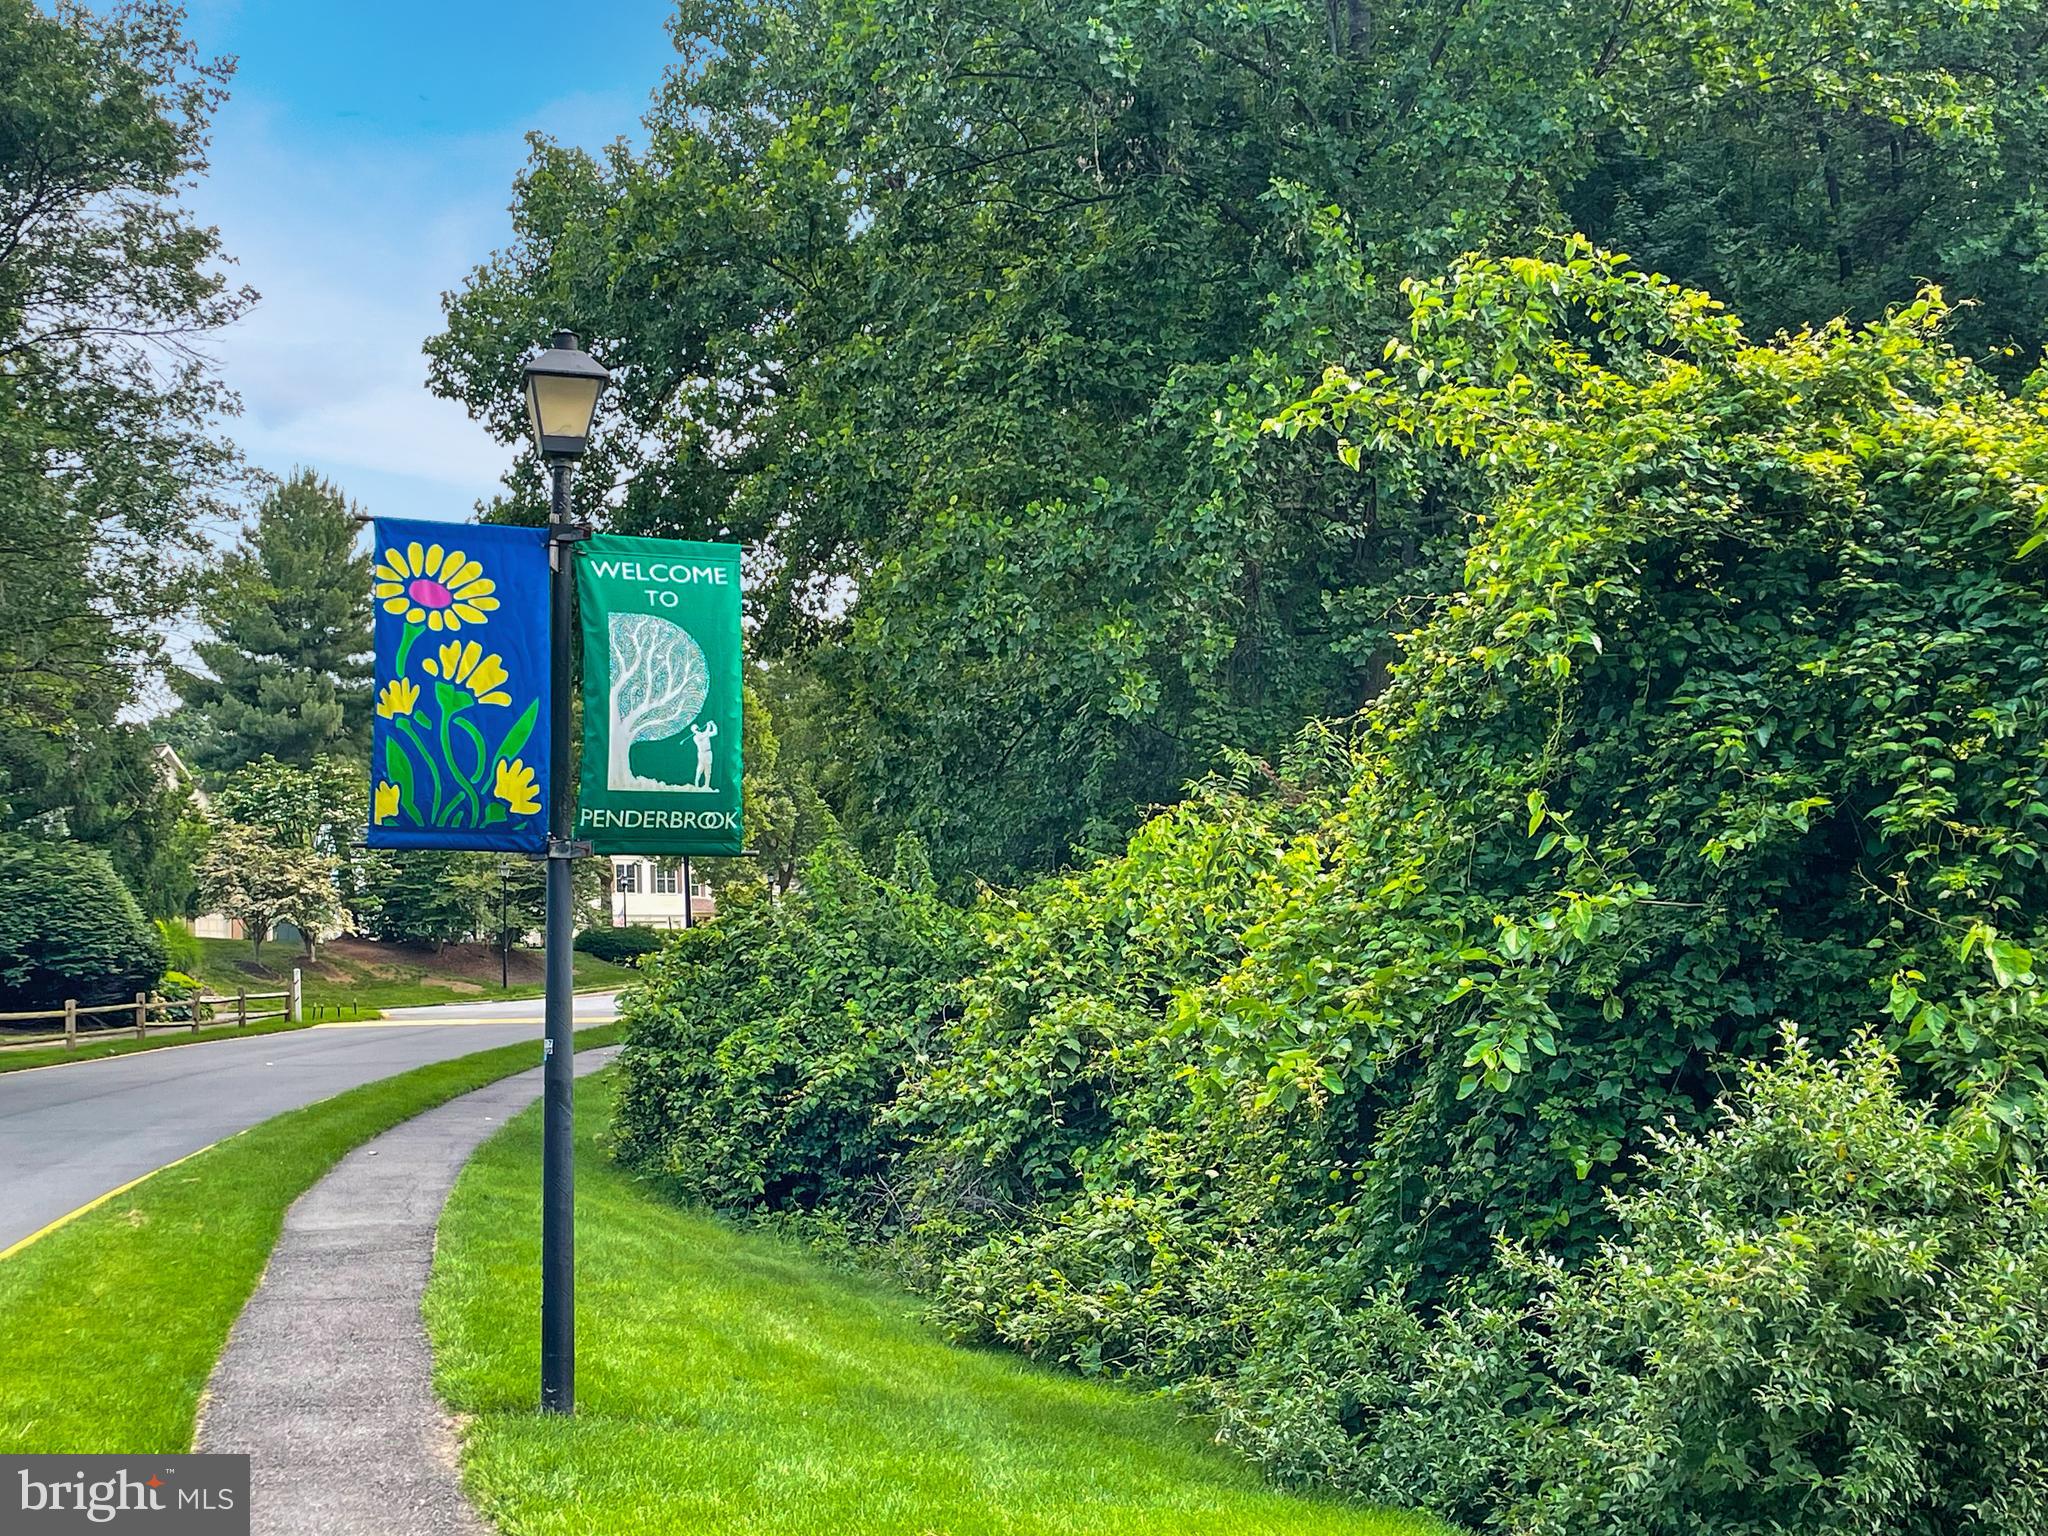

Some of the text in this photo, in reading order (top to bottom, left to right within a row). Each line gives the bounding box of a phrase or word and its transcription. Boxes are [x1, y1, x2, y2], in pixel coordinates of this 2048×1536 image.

[591, 560, 729, 585] WELCOME
[644, 590, 679, 608] TO
[579, 808, 738, 831] PENDERBROOK
